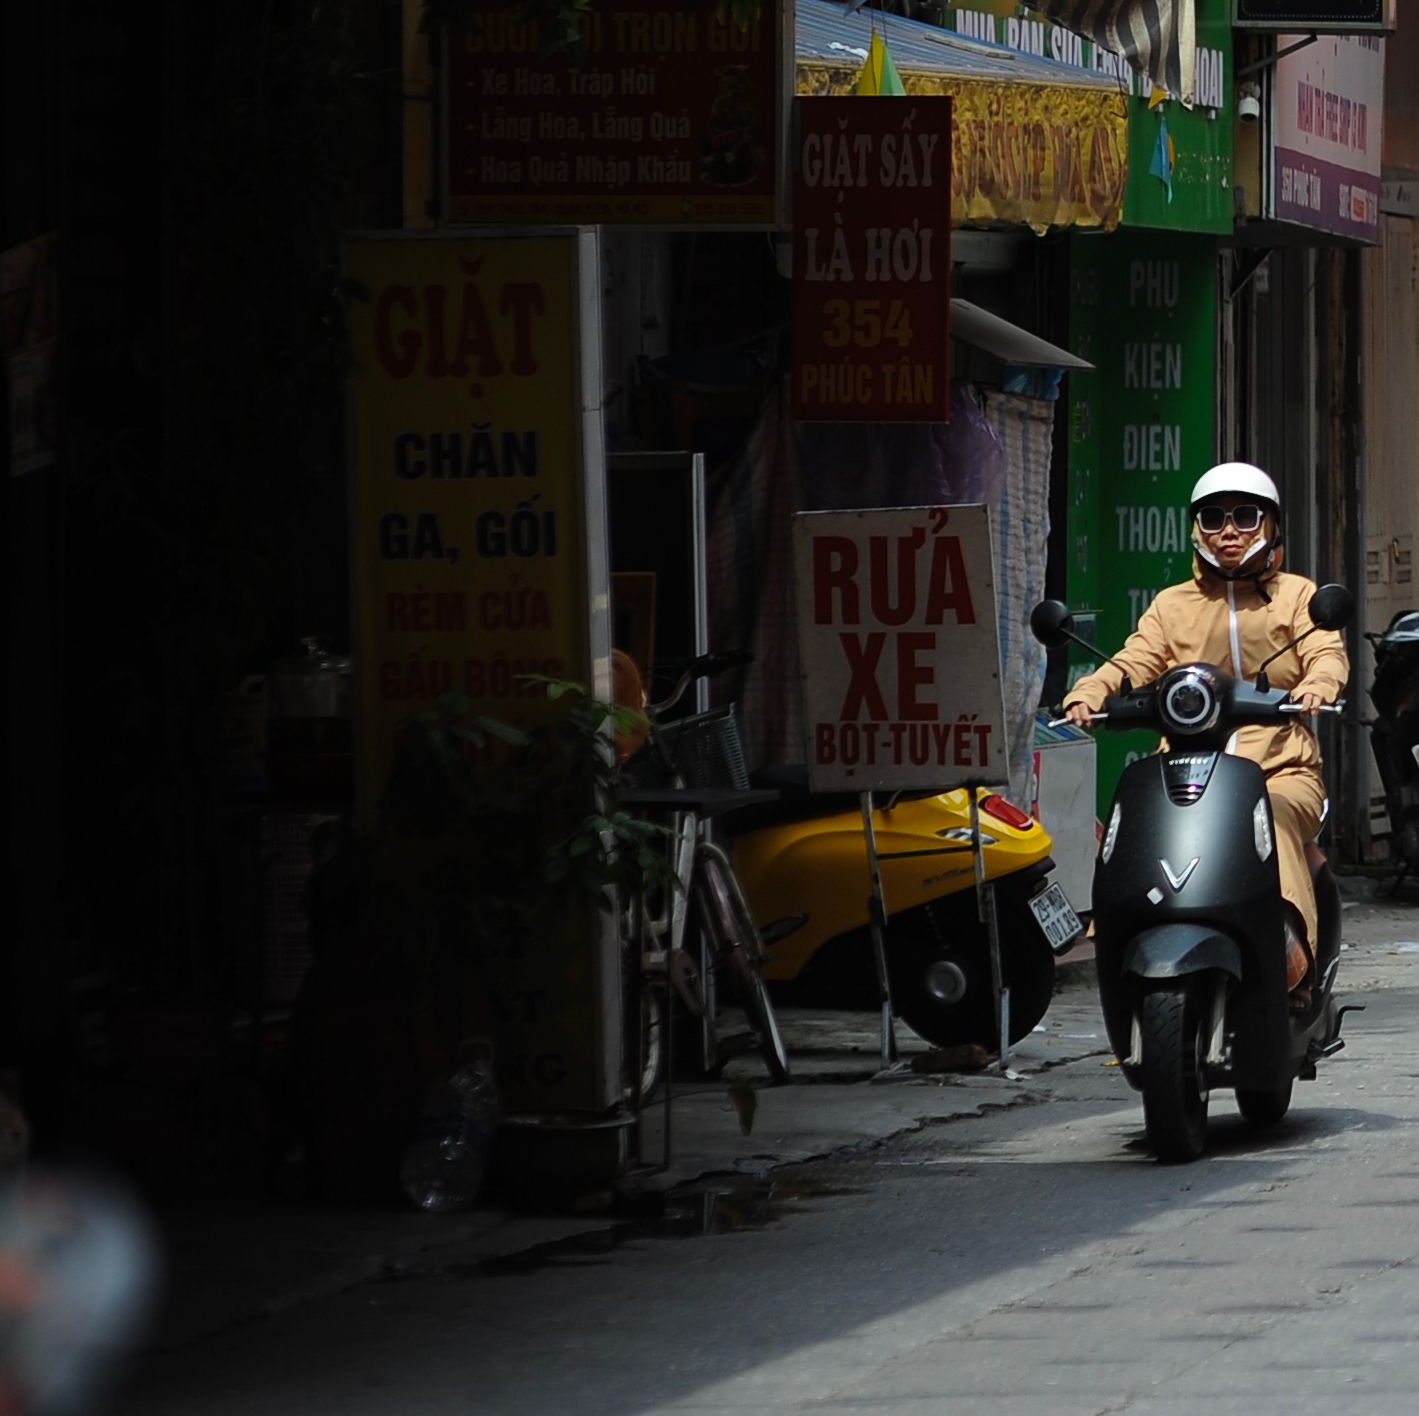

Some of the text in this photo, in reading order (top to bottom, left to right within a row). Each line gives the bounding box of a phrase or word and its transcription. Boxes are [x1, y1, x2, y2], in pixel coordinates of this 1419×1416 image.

[802, 115, 874, 202] GIẶT
[880, 107, 940, 189] SẤY
[821, 297, 914, 350] 354
[1130, 260, 1180, 318] PHỤ
[374, 253, 546, 400] GIẶT
[801, 359, 934, 405] PHÚC TÂN
[1123, 331, 1183, 400] KIỆN
[394, 422, 538, 480] CHĂN
[1122, 411, 1182, 483] ĐIỆN
[379, 493, 558, 564] GA, GỐI
[811, 506, 977, 628] RỬA
[839, 630, 940, 723] XE
